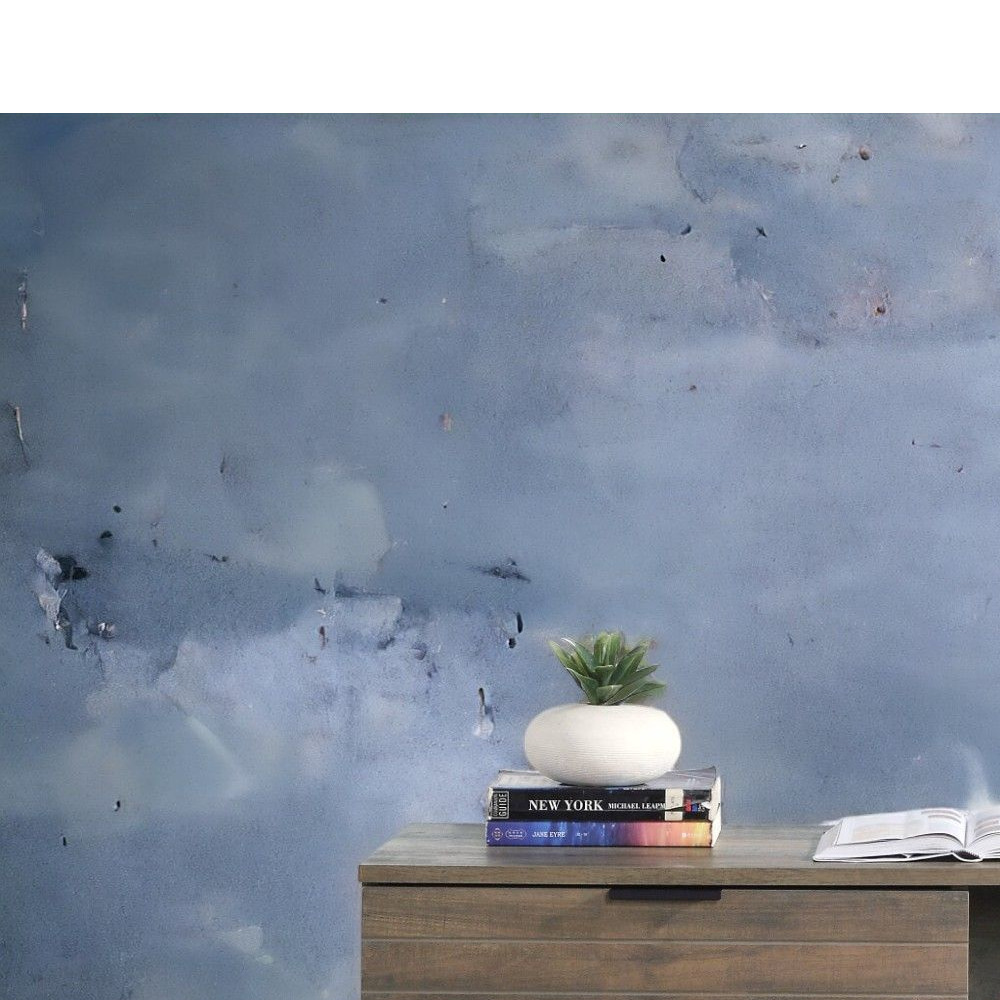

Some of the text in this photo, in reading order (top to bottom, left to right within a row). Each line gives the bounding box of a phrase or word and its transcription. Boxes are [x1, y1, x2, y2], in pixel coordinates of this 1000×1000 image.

[498, 793, 507, 817] GUIDE
[528, 799, 604, 811] NEW YORK
